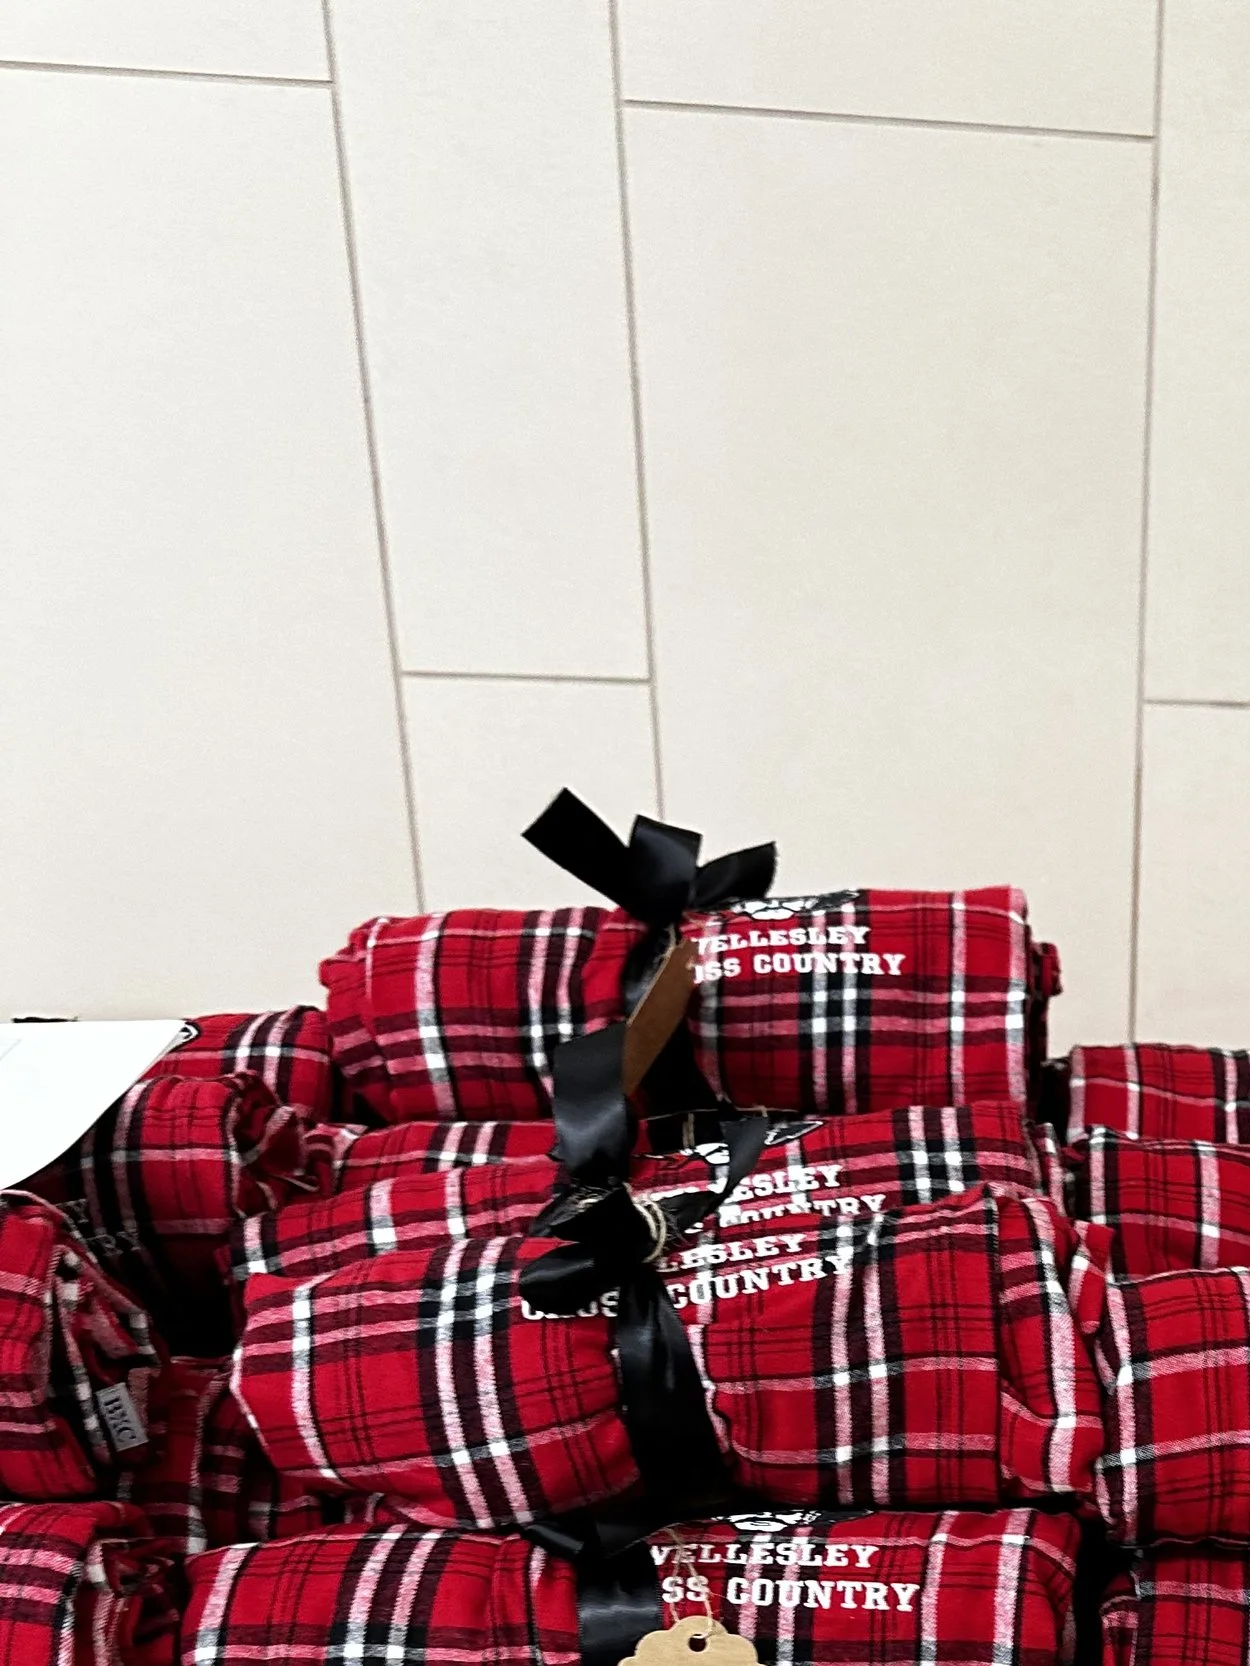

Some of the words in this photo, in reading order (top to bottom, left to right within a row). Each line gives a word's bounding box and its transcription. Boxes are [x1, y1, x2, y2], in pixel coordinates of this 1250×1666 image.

[753, 952, 906, 976] COUNTRY
[667, 1252, 856, 1310] COUNTRY
[726, 1577, 920, 1612] COUNTRY
